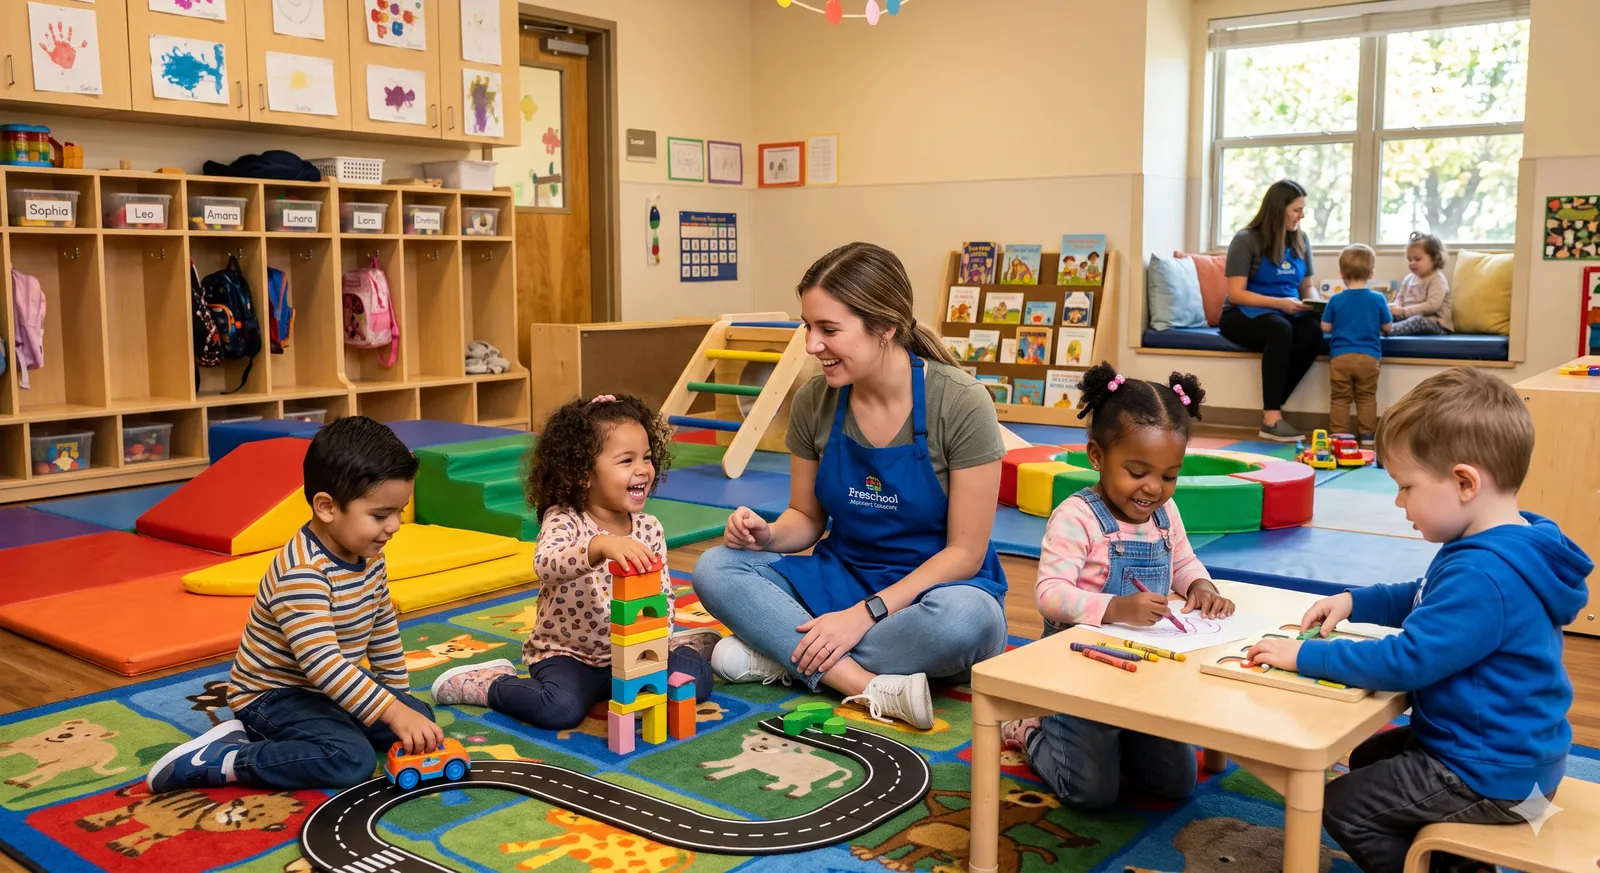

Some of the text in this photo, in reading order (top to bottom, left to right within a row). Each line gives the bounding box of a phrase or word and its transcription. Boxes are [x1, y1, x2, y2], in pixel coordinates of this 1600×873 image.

[29, 203, 69, 219] Sophia
[134, 208, 154, 219] Leo
[206, 209, 238, 220] Amara
